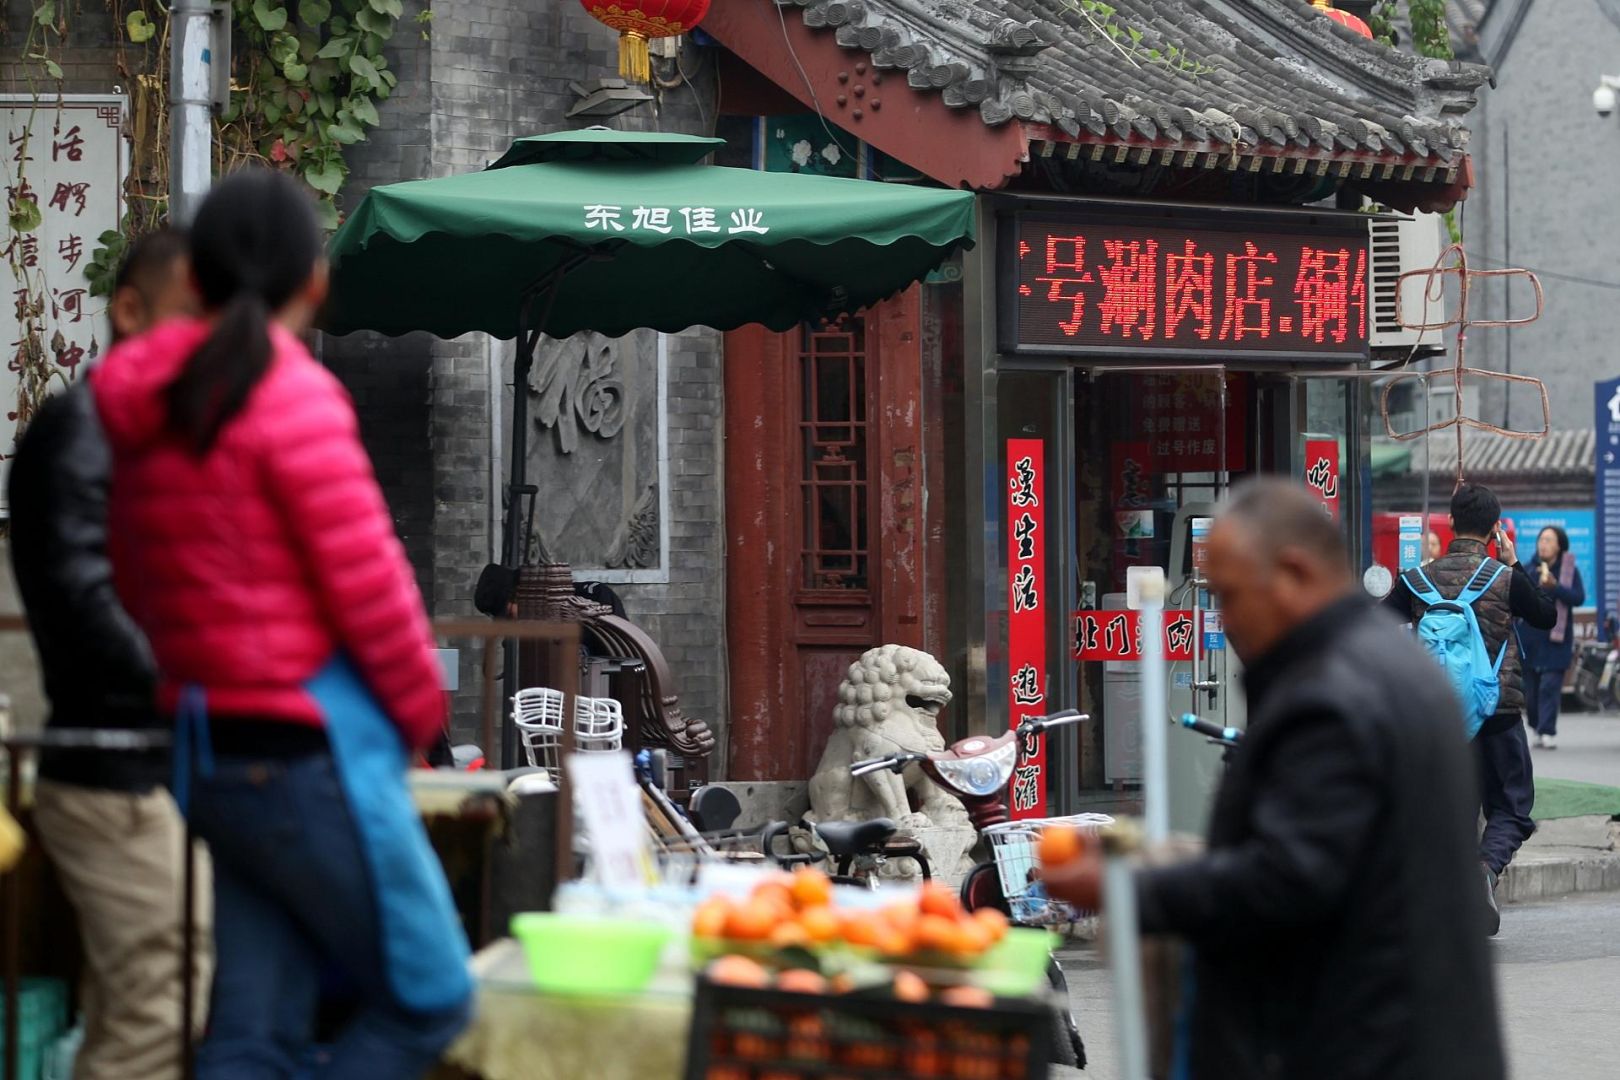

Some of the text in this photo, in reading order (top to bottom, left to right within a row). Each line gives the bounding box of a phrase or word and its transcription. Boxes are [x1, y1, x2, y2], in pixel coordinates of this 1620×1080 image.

[583, 204, 770, 235] 东旭佳业
[1076, 614, 1193, 656] 北门肉
